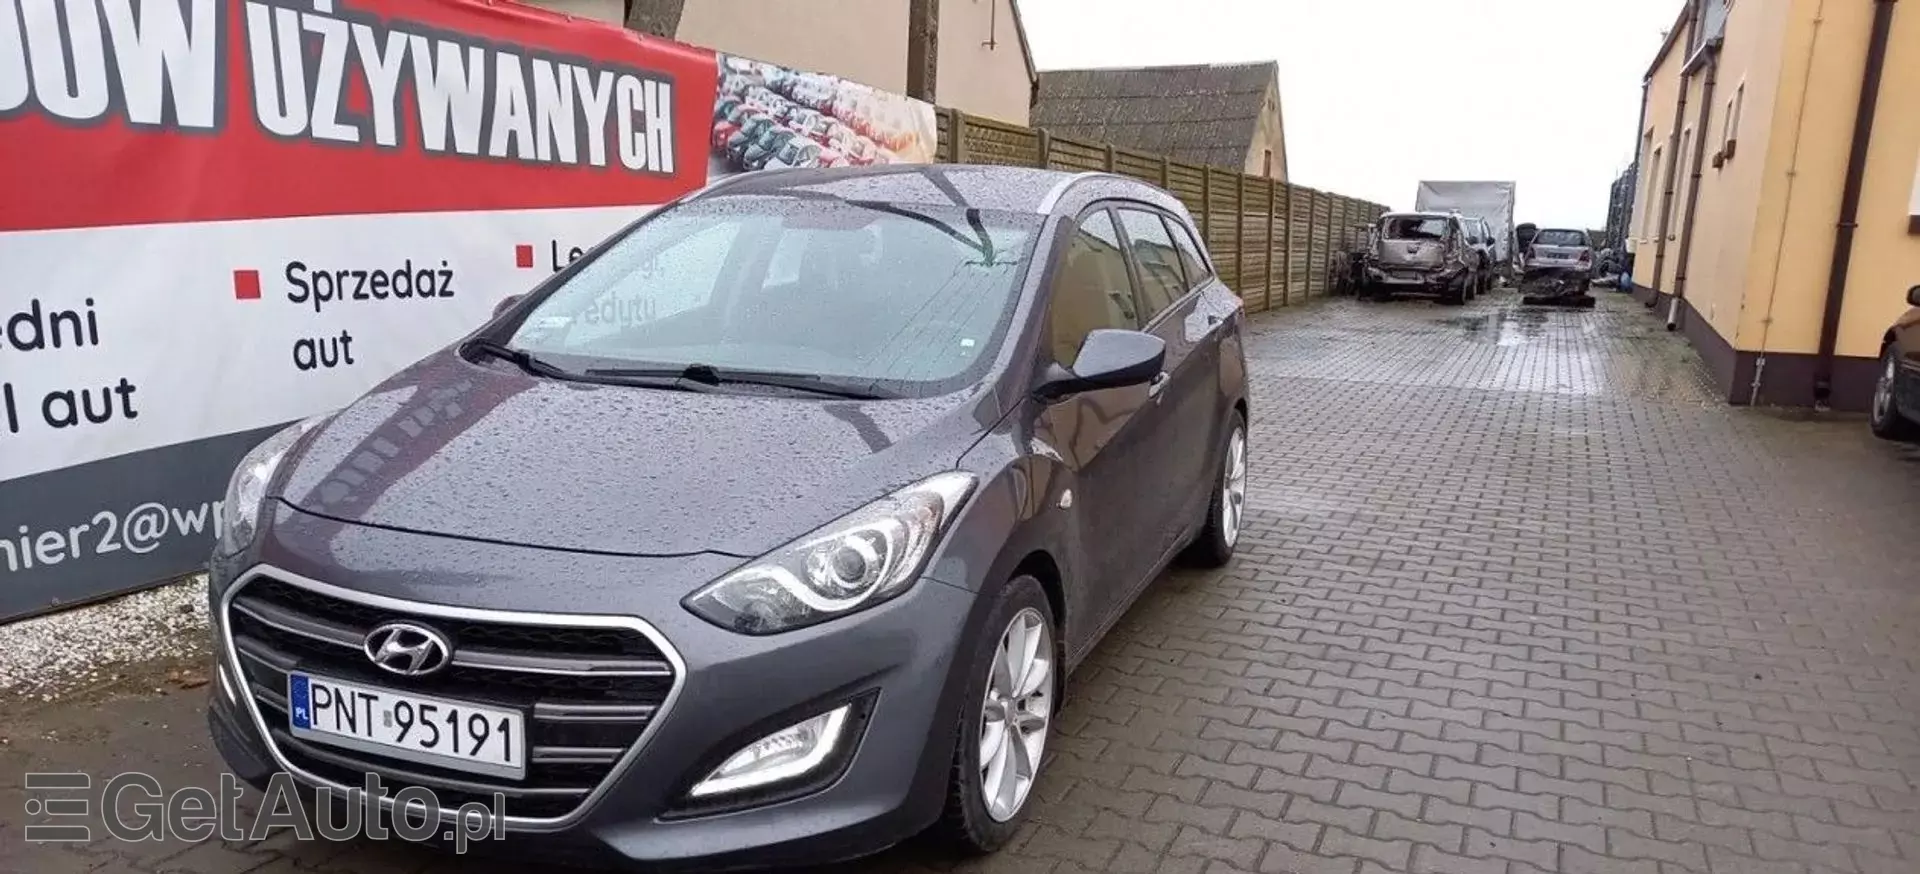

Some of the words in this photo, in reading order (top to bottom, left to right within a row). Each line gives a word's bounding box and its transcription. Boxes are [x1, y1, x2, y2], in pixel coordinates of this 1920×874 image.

[246, 0, 674, 174] UŻYWANYCH
[286, 259, 455, 313] Sprzedaż
[293, 329, 355, 371] aut
[42, 377, 138, 428] aut
[295, 706, 309, 720] PL
[311, 683, 379, 737] PNT
[394, 700, 511, 762] 95191
